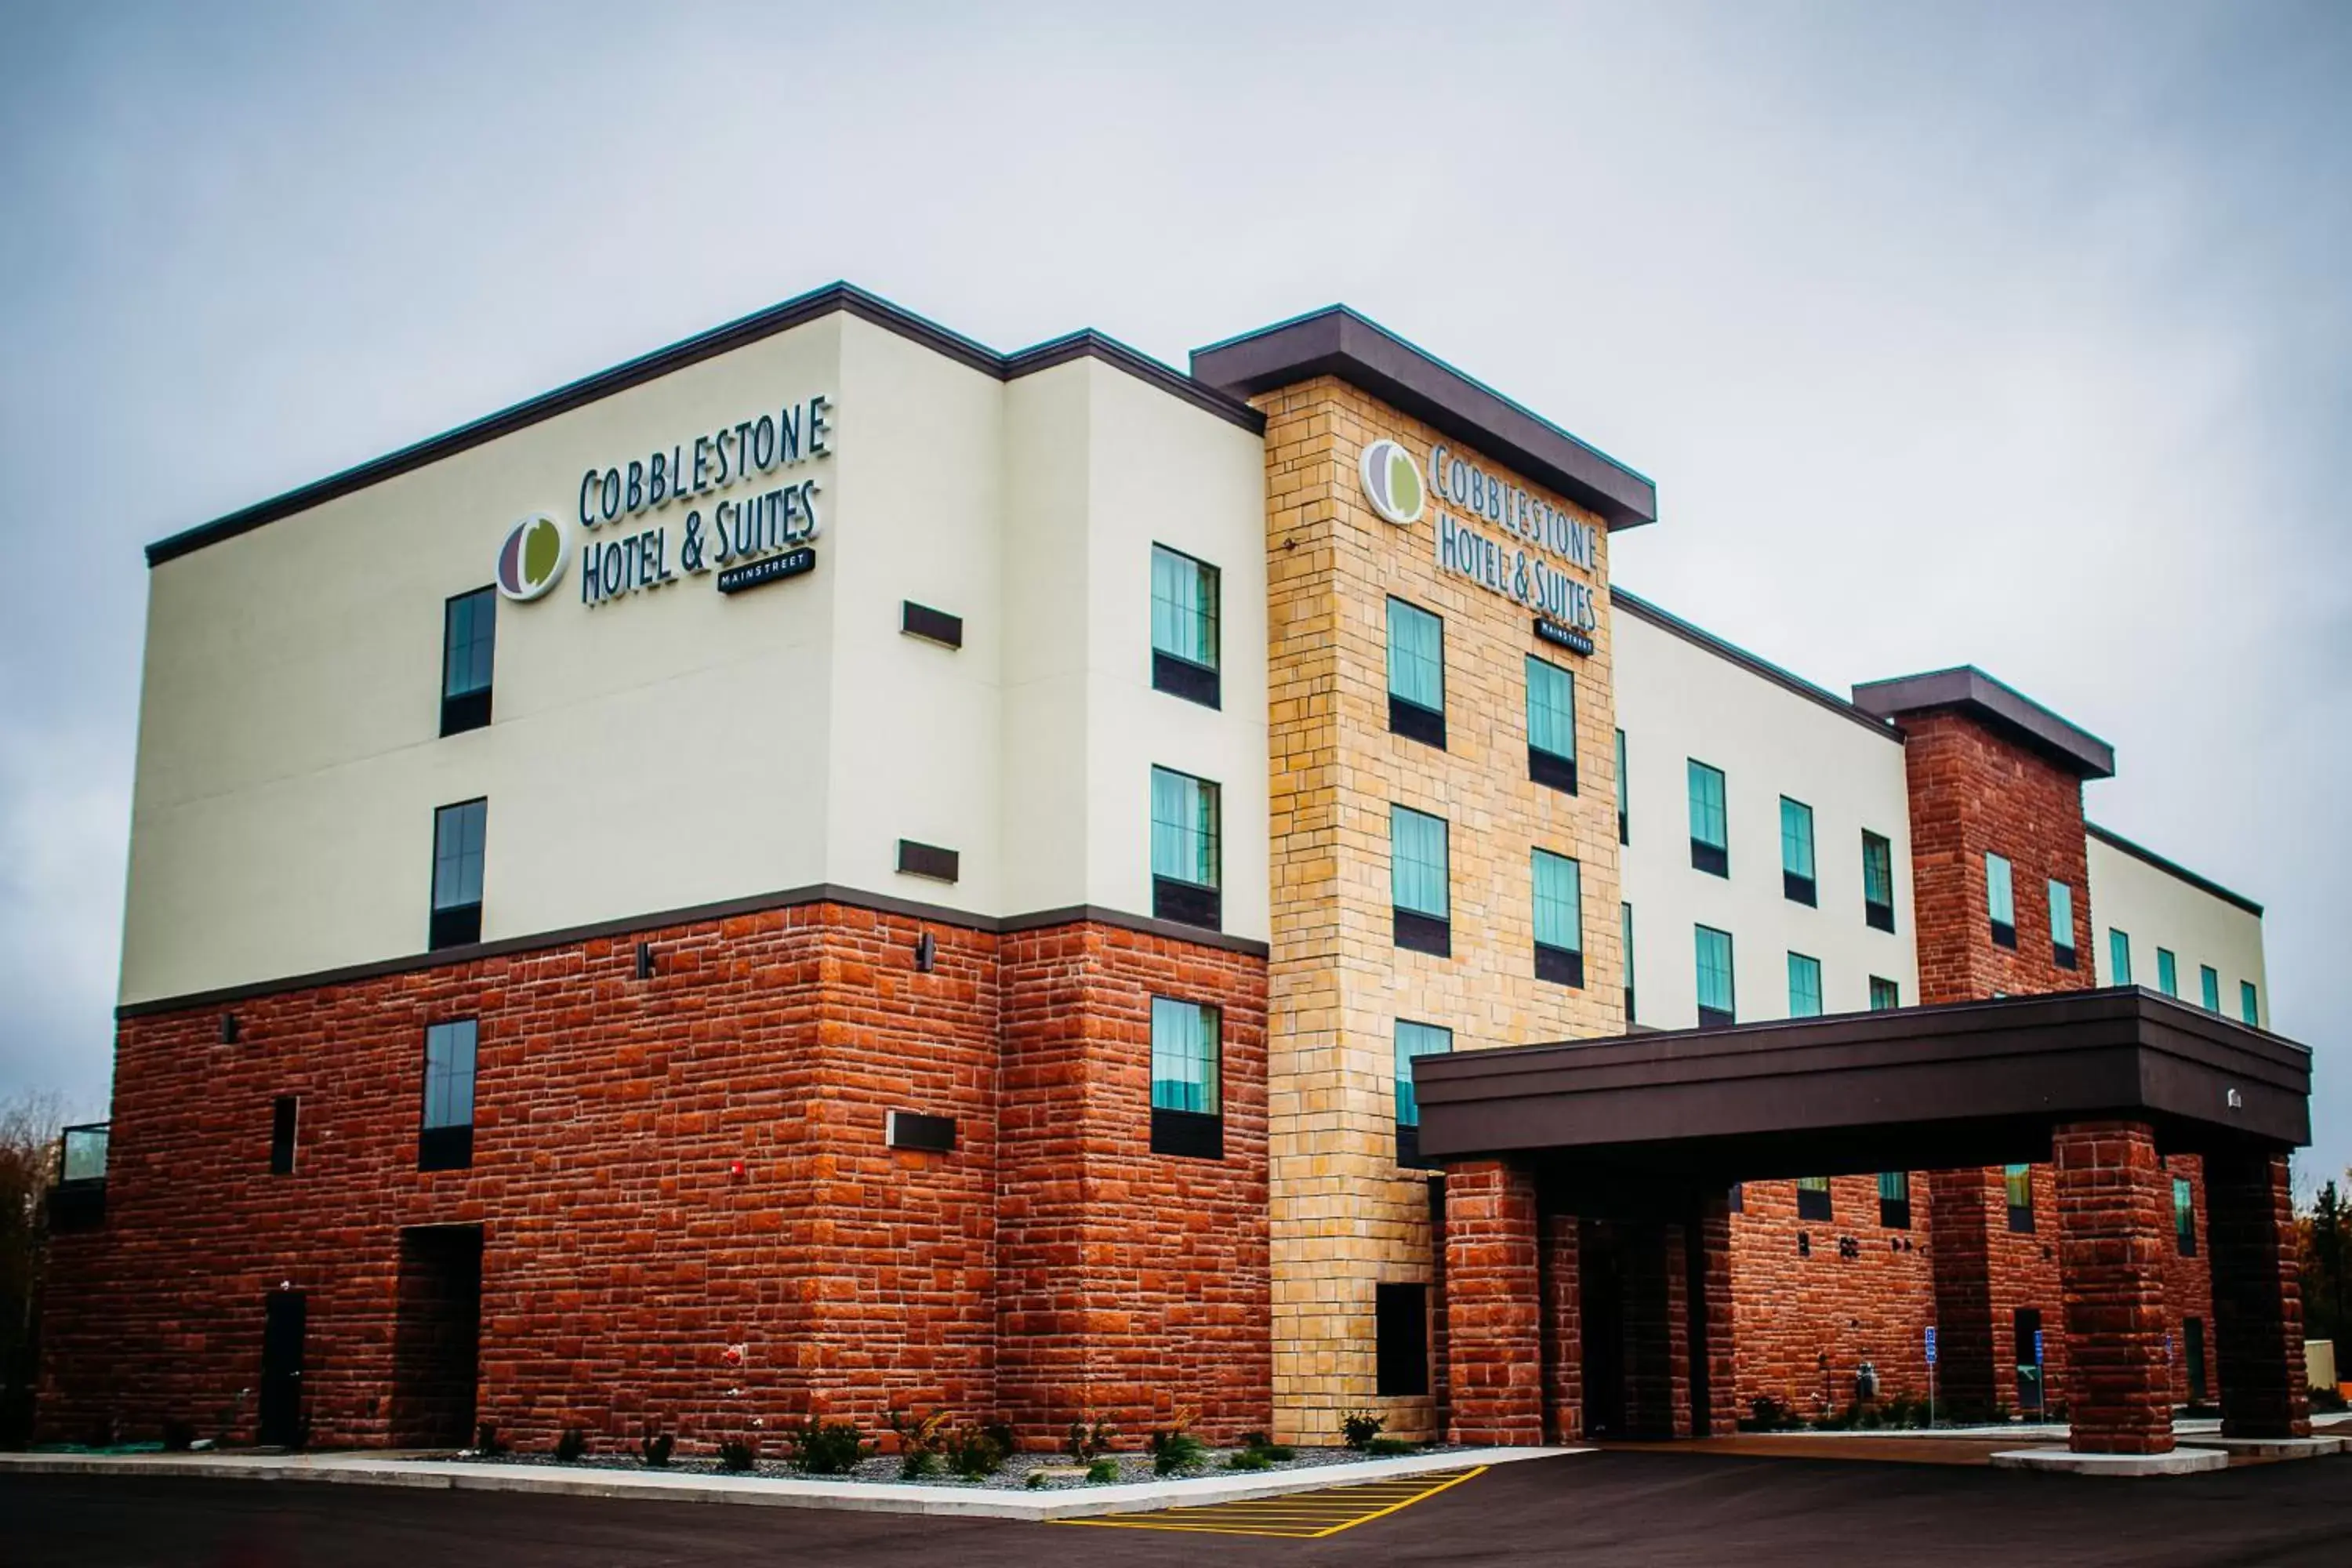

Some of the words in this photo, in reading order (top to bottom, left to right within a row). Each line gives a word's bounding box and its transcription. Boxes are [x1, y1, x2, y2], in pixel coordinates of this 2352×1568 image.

[579, 395, 829, 528] COBBLESTONE
[1432, 444, 1597, 571] COBBLESTONE
[581, 527, 673, 605] HOTEL
[681, 510, 707, 572] &
[713, 479, 817, 564] SUITES
[721, 553, 804, 586] MAINSTREET
[1439, 513, 1508, 592] HOTEL
[1512, 550, 1530, 604] &
[1534, 559, 1597, 632] SUITES
